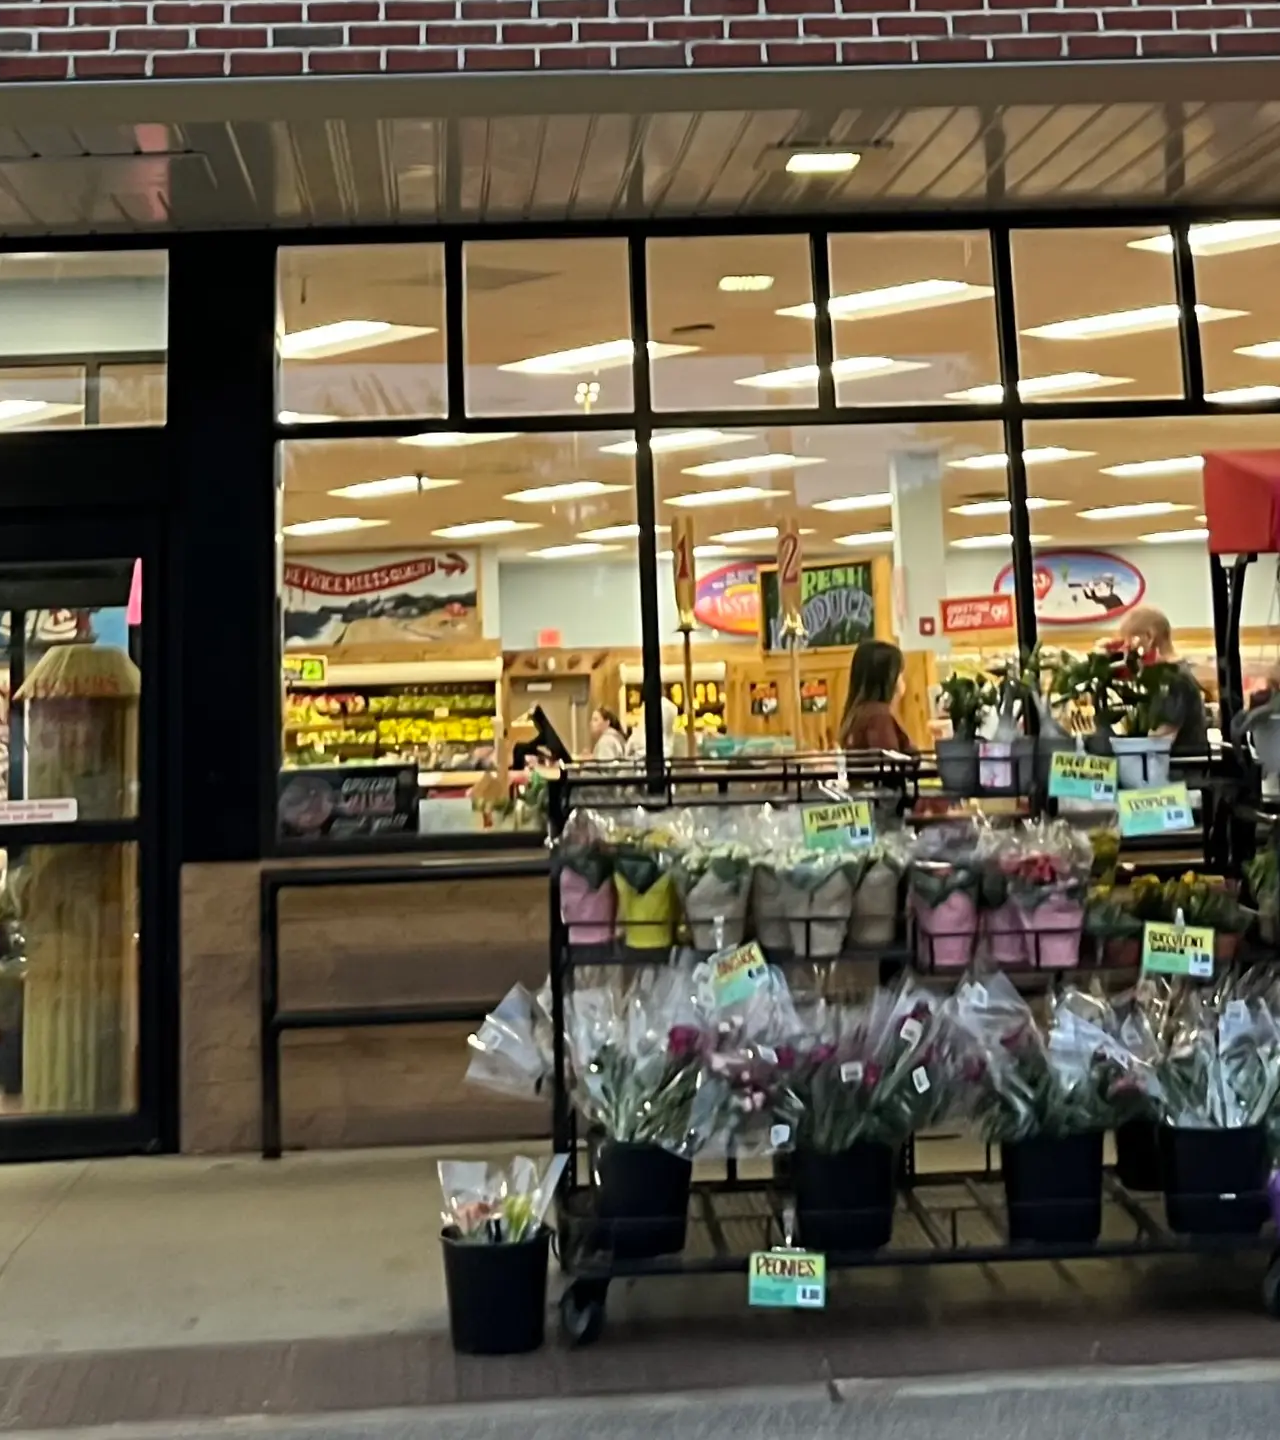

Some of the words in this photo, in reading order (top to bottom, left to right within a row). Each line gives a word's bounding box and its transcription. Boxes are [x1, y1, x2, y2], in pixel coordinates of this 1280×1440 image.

[781, 535, 800, 582] 2
[345, 570, 389, 592] MEETS
[802, 566, 863, 600] RESH
[756, 1253, 816, 1278] PEONIES
